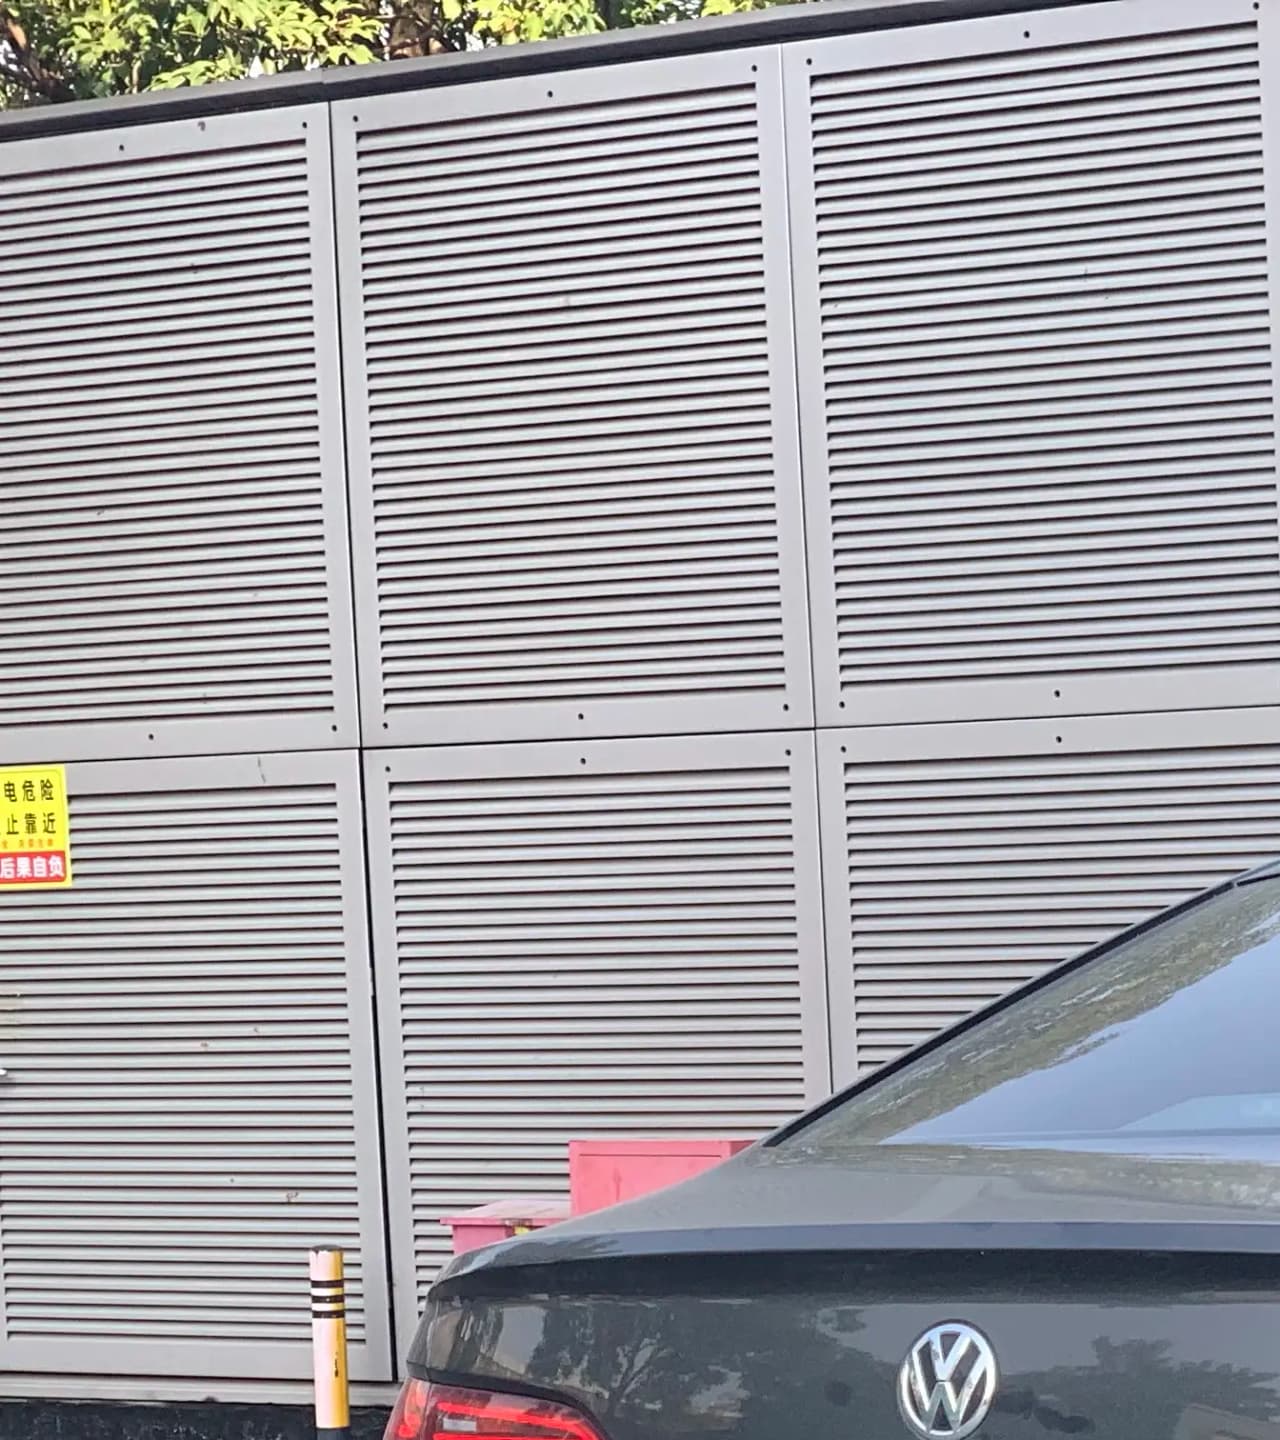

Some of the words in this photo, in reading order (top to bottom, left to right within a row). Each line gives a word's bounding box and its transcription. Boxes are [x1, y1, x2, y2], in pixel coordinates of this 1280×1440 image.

[0, 812, 56, 836] 止靠近
[0, 855, 65, 879] 后果自负
